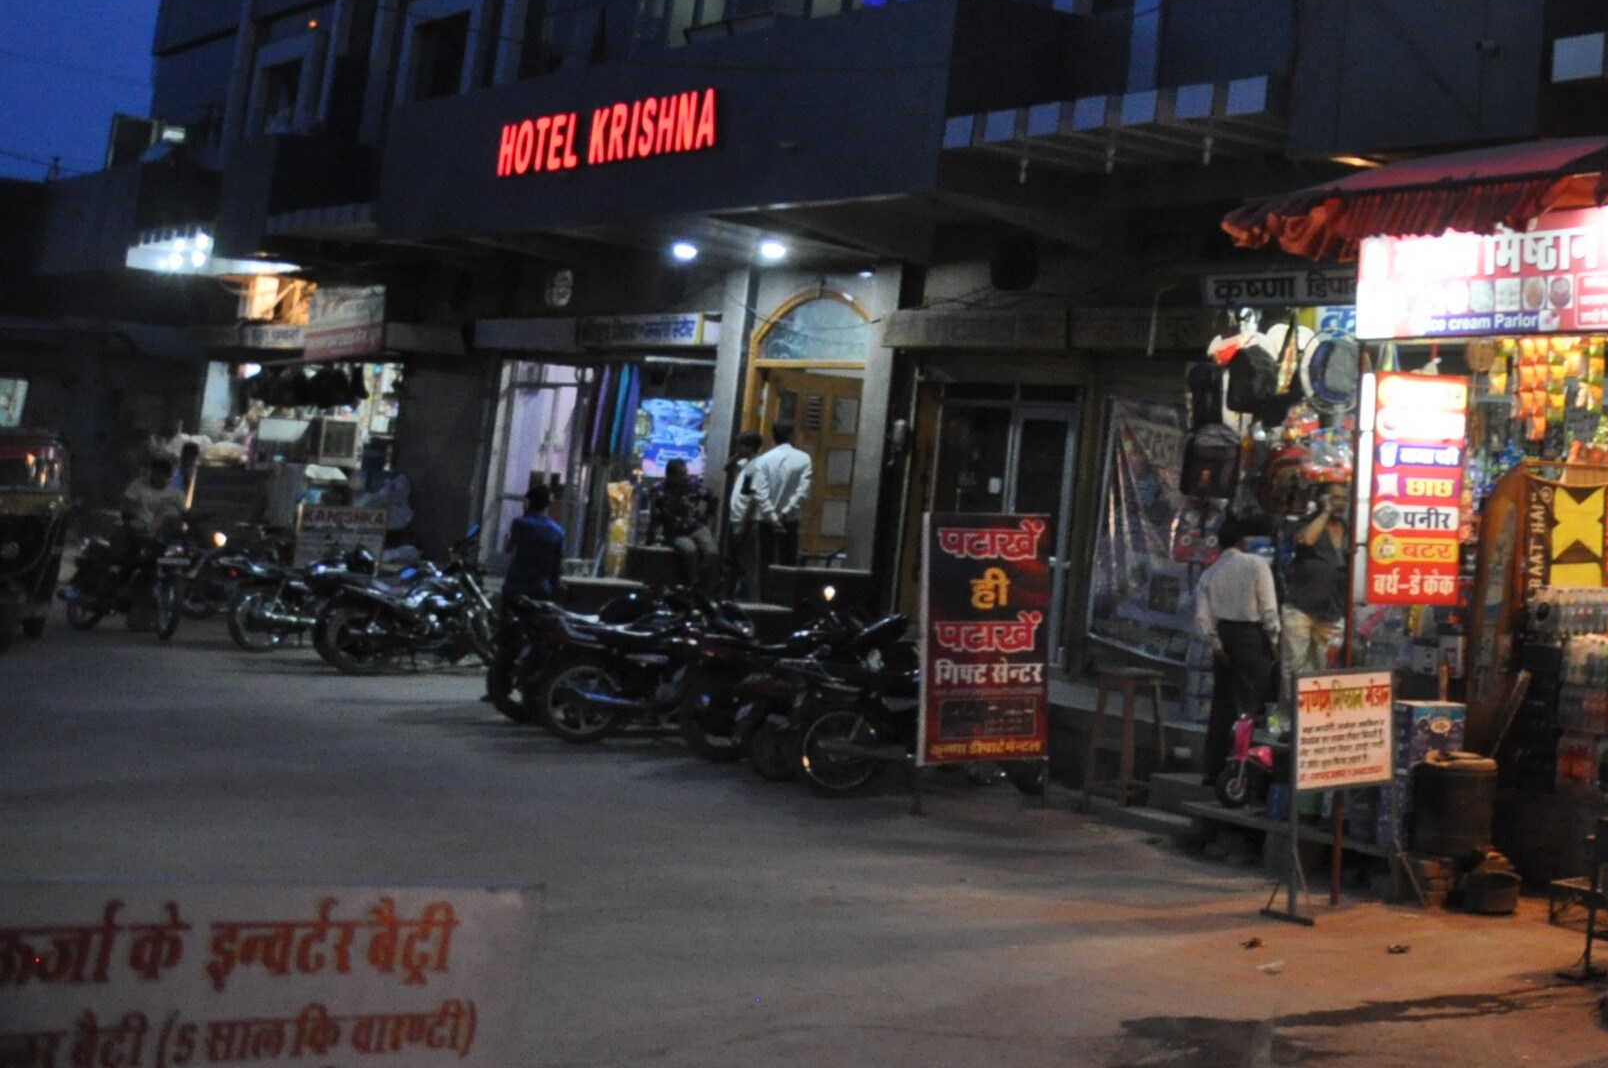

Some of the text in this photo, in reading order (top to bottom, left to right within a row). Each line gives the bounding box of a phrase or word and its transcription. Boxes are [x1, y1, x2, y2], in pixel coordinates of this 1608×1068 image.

[497, 87, 715, 177] HOTEL KRISHNA
[1448, 317, 1490, 331] cream
[1494, 313, 1537, 329] Parlor
[1406, 477, 1455, 497] छाछ
[1403, 507, 1452, 530] पनीर
[937, 518, 1045, 561] पटाखें
[1401, 543, 1452, 560] बटर
[969, 566, 1012, 611] ही
[1423, 569, 1455, 595] केक
[934, 610, 1043, 652] पटाखें
[128, 900, 192, 981] के
